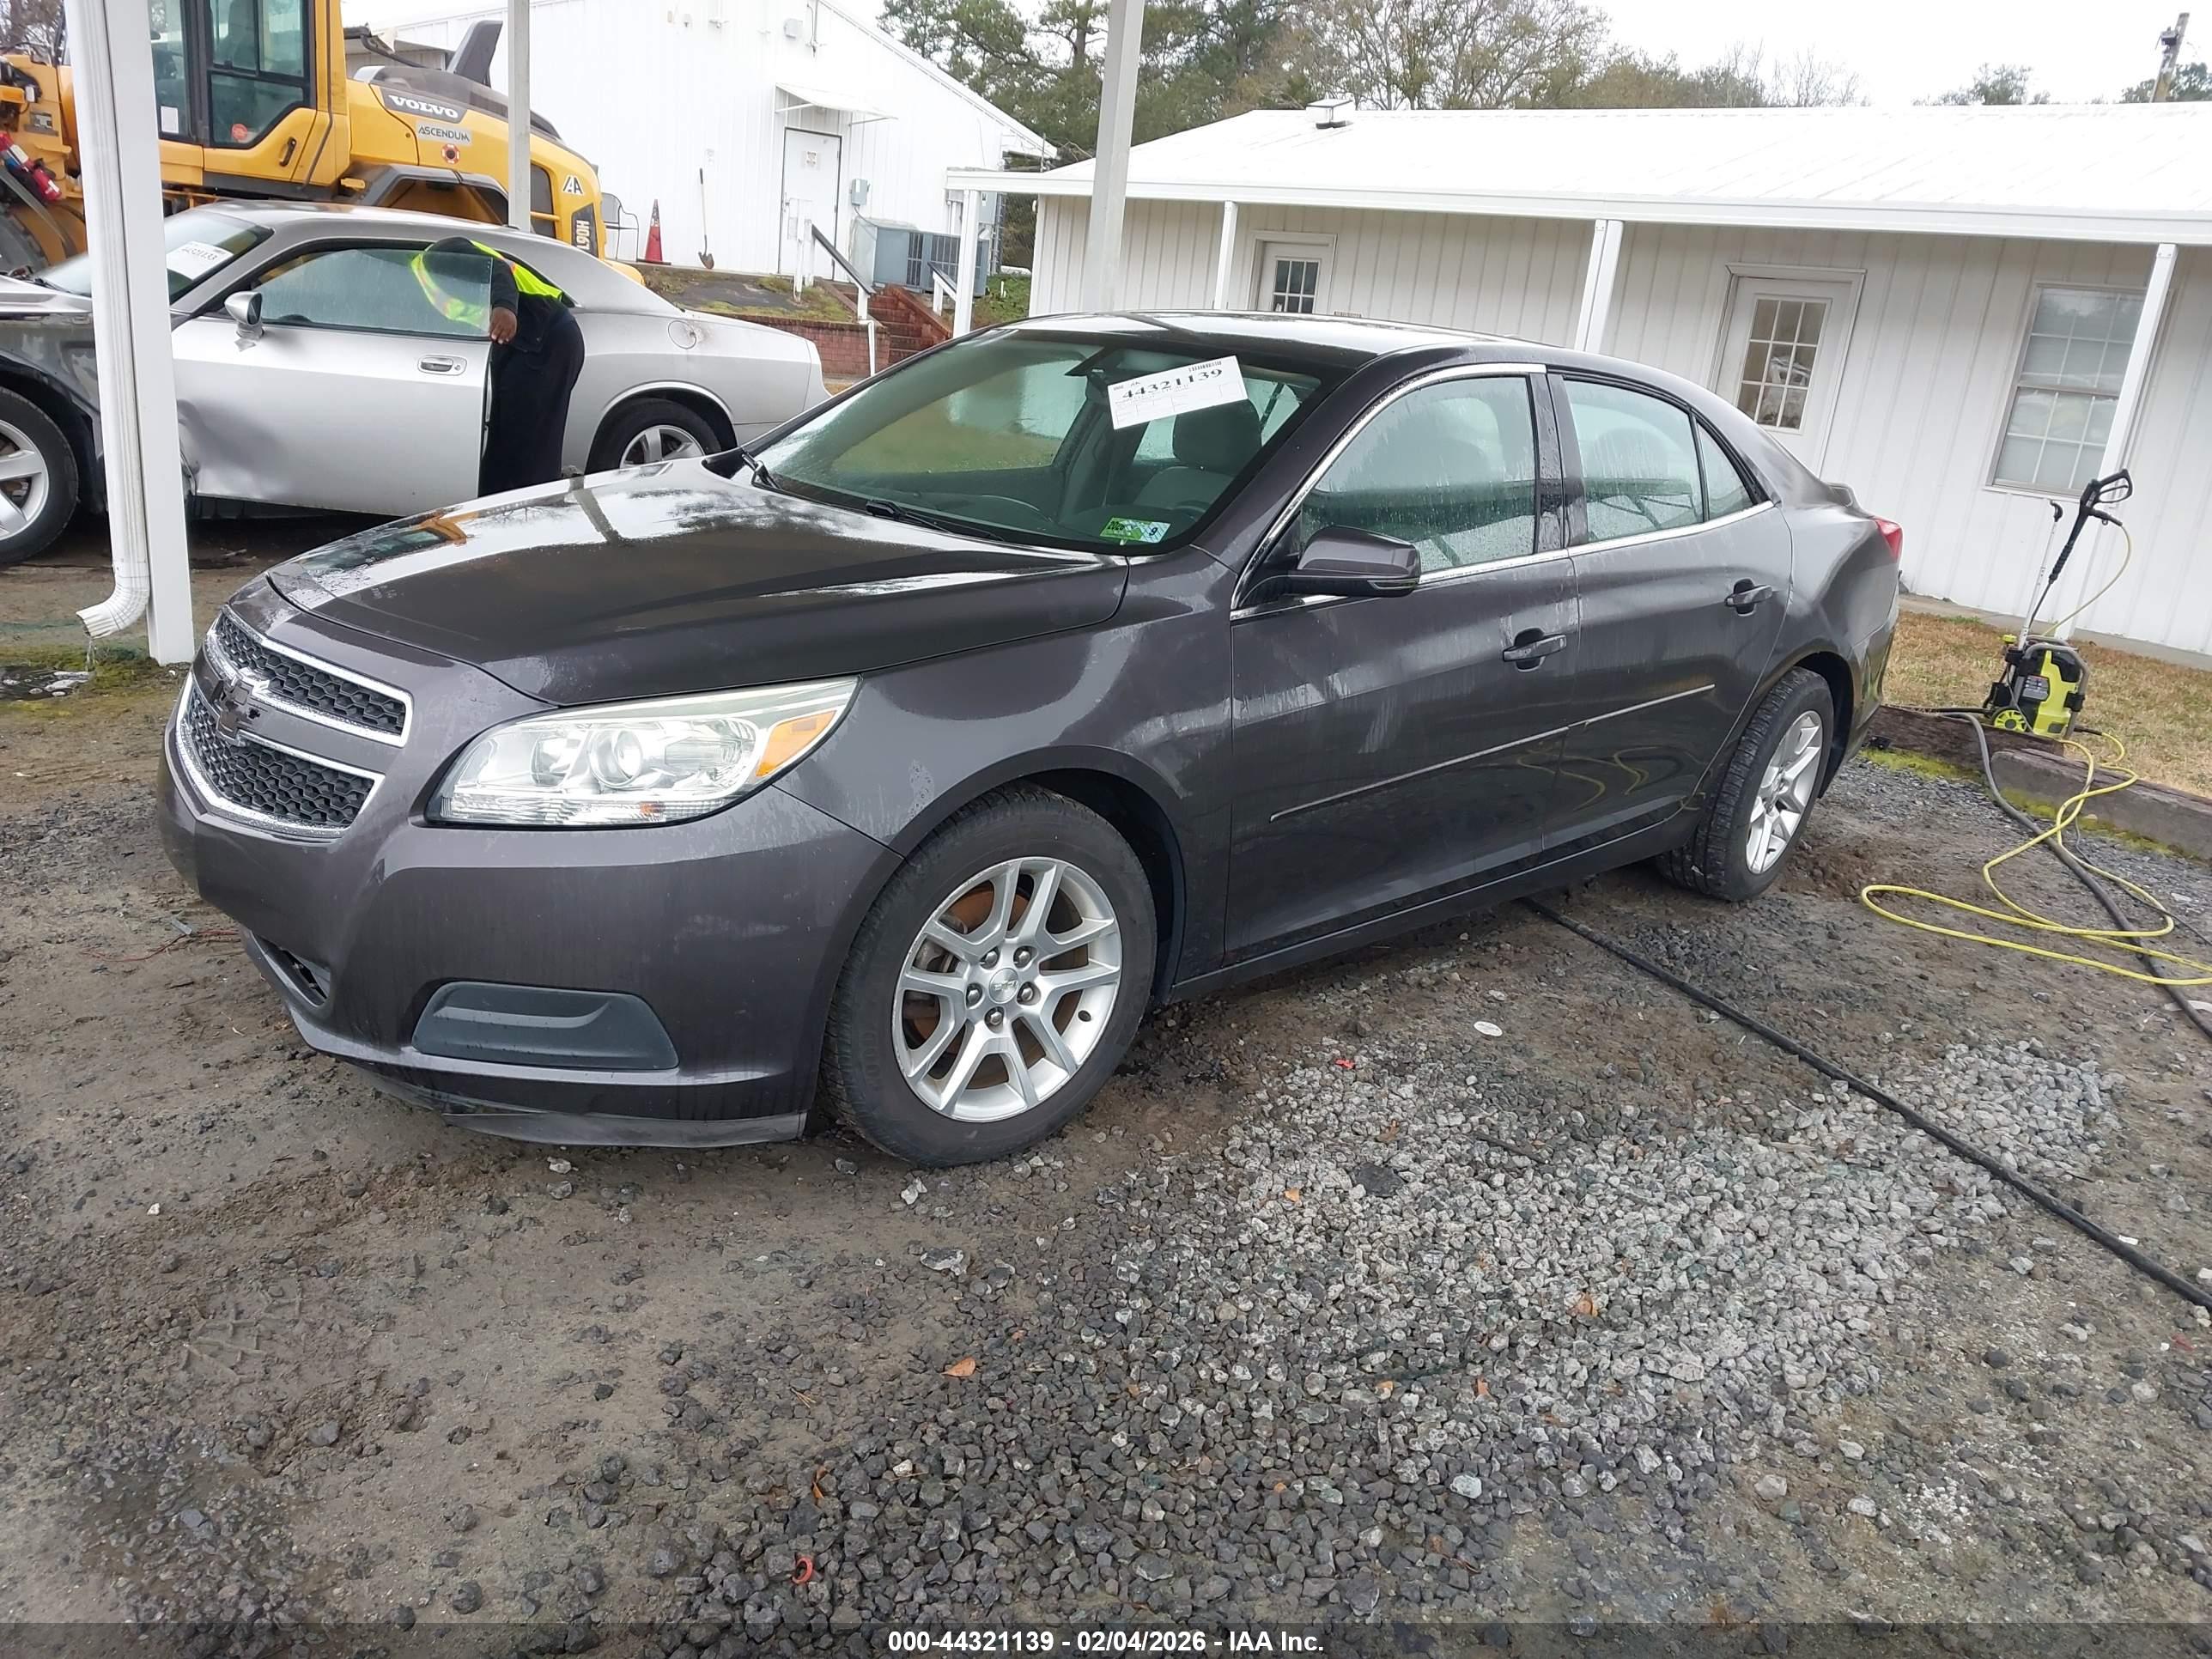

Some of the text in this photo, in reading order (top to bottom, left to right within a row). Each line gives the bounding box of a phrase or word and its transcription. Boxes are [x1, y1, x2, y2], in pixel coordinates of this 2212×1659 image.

[388, 94, 459, 118] VOLVO
[418, 126, 470, 142] ASCENDUM
[575, 219, 591, 250] L90H
[1122, 368, 1222, 398] 44321139
[1148, 526, 1158, 536] 9
